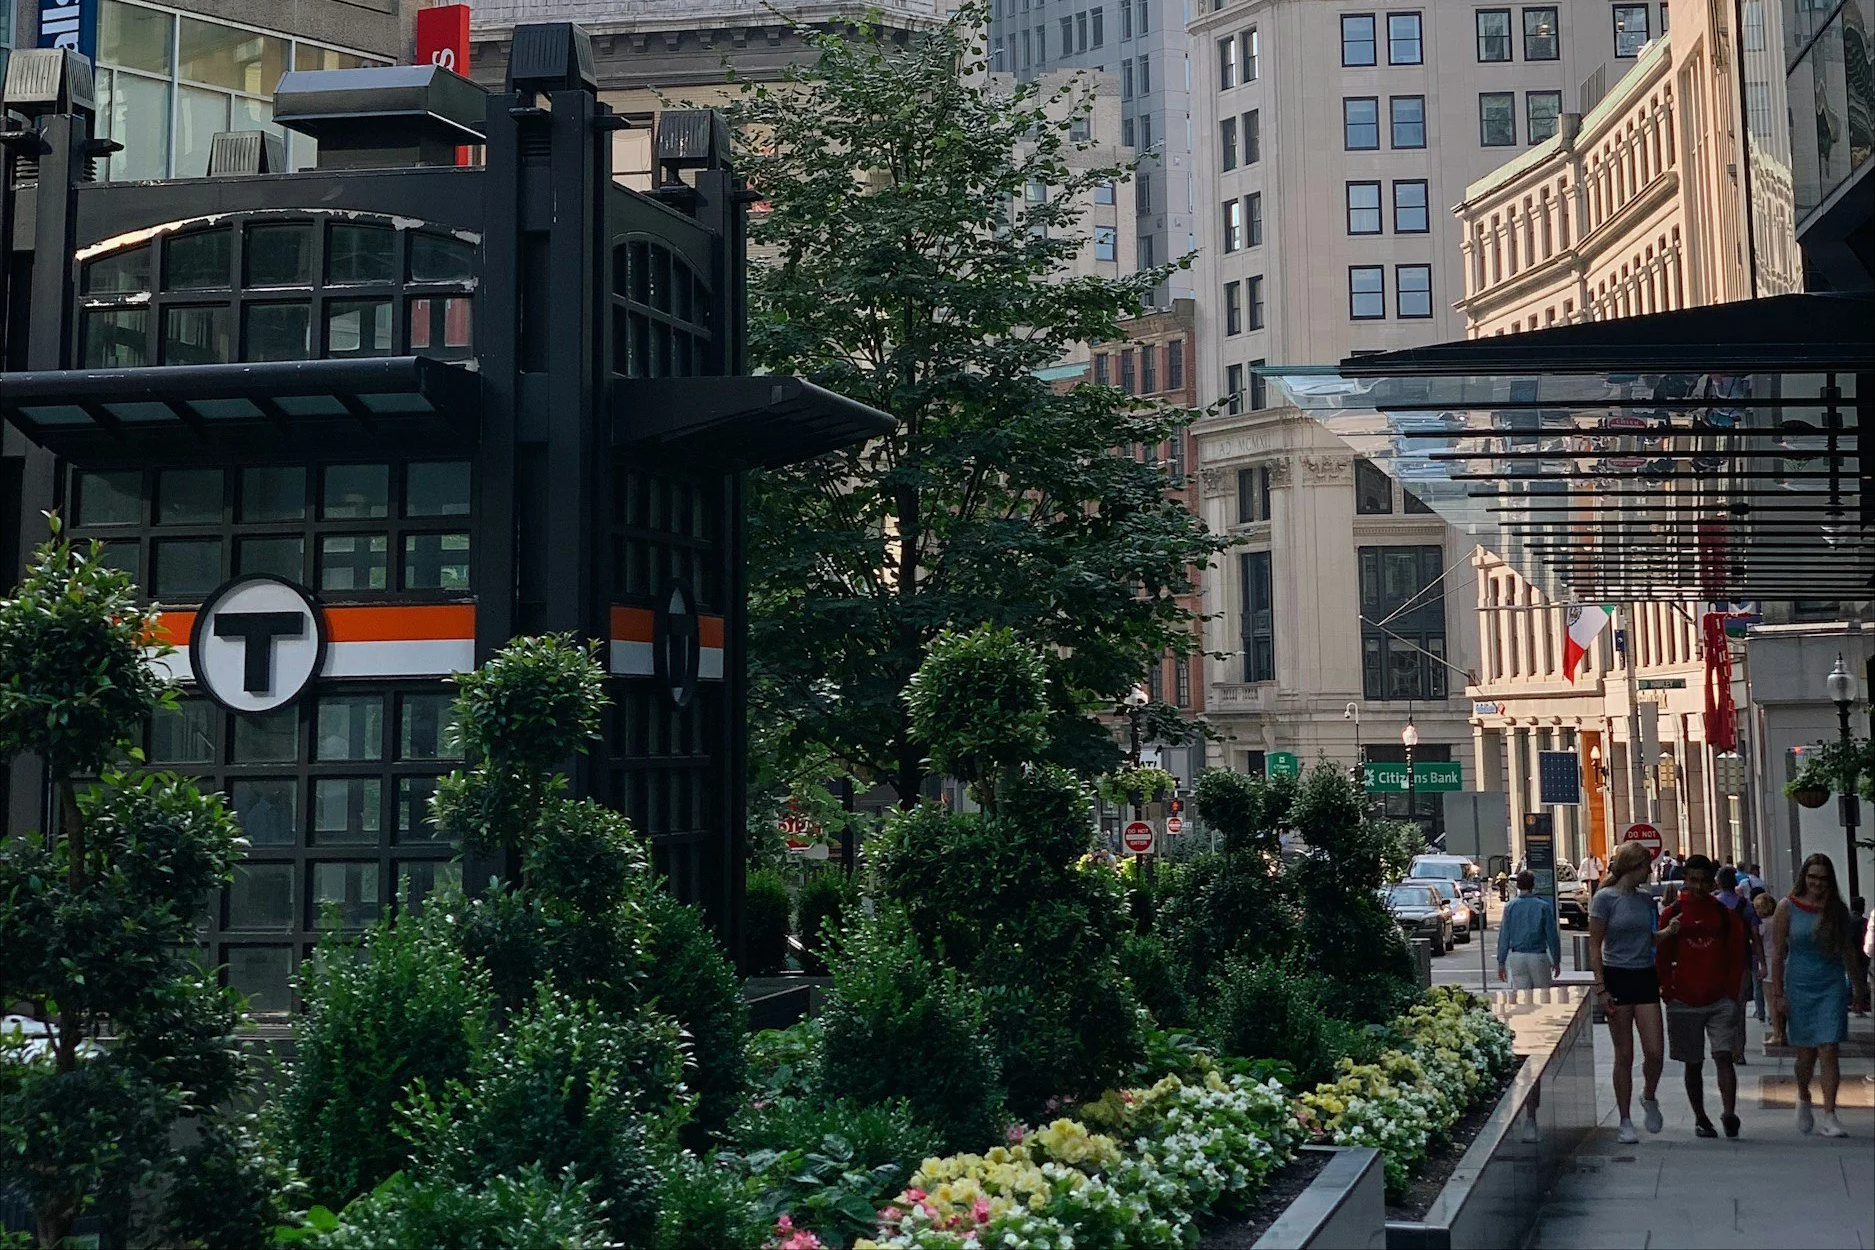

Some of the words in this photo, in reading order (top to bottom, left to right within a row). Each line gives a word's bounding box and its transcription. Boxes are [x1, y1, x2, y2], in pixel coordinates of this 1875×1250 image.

[214, 612, 303, 692] T
[1378, 771, 1428, 784] Citizns
[1430, 771, 1458, 784] Bank
